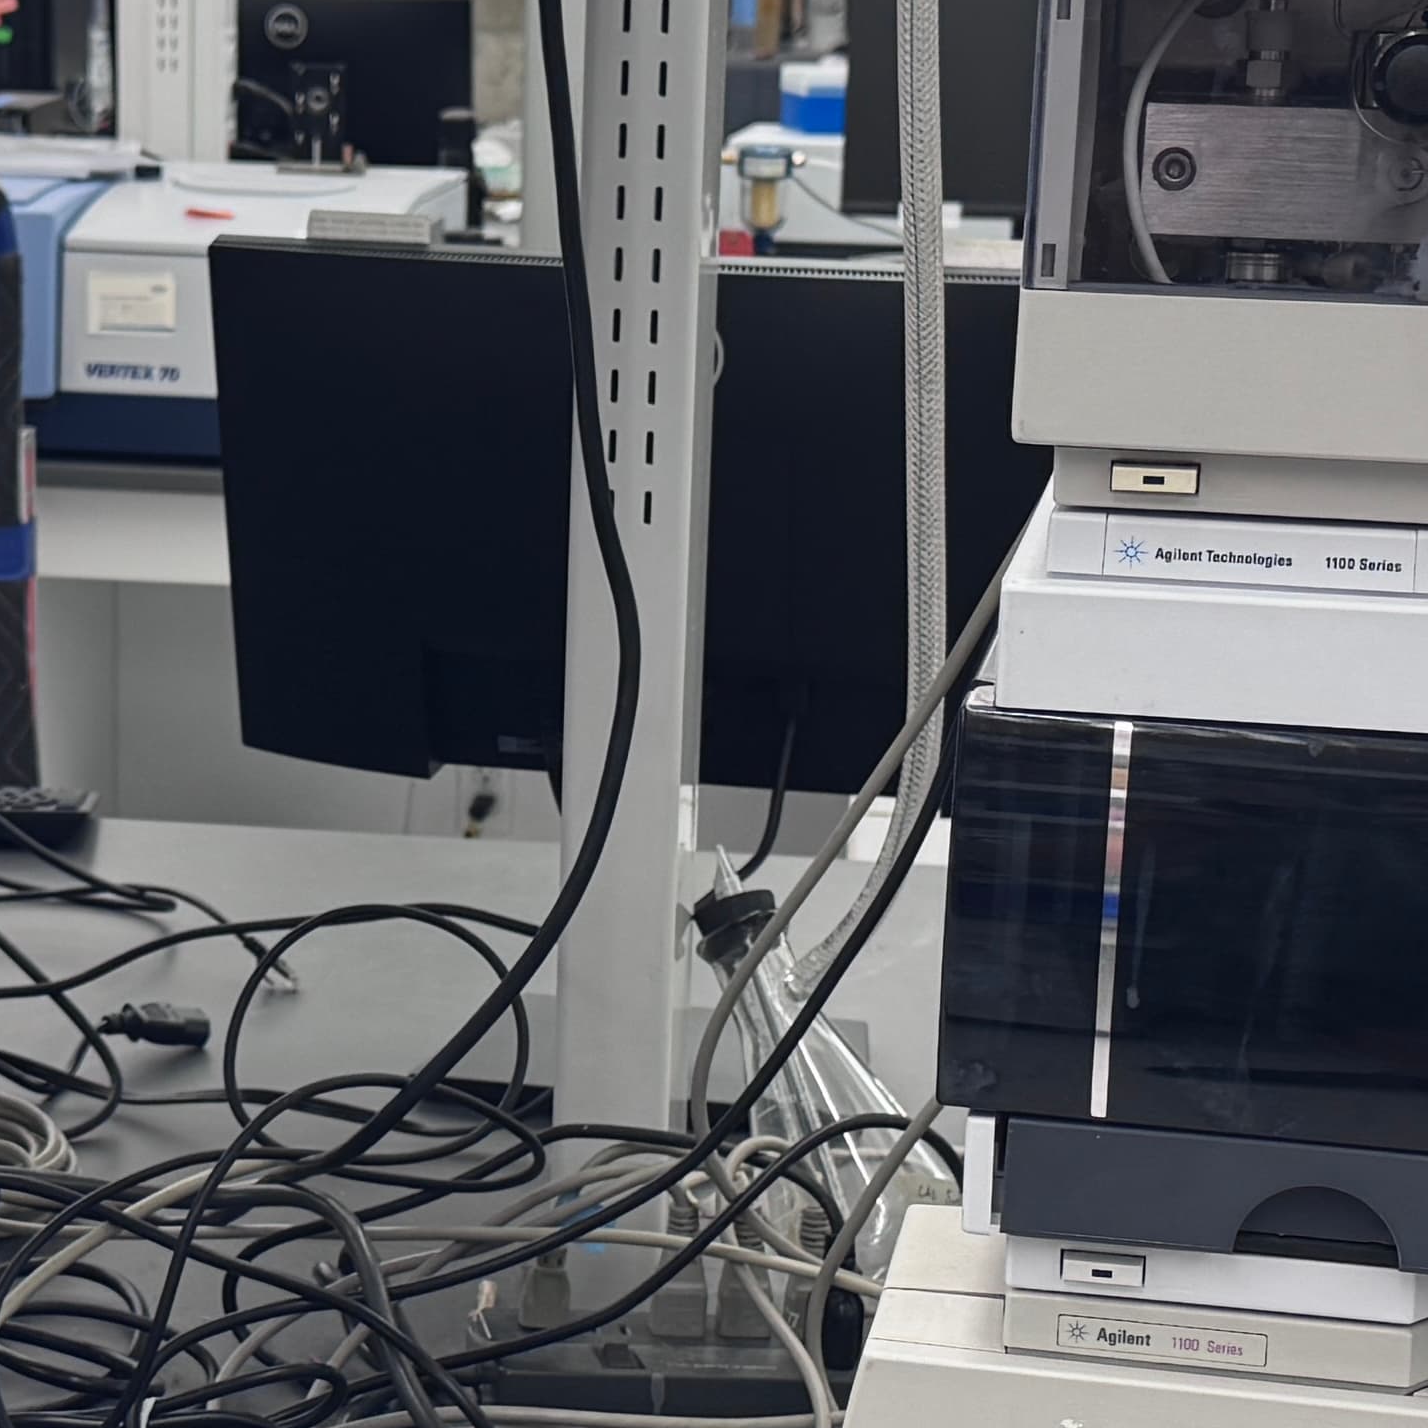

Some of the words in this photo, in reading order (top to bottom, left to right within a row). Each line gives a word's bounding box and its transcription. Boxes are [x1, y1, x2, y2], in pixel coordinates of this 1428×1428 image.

[1155, 546, 1203, 563] Agilent
[1206, 549, 1293, 568] Technologies
[1325, 555, 1356, 571] 1100
[1359, 558, 1402, 573] Series
[1097, 1327, 1151, 1347] Agilent
[1172, 1336, 1199, 1352] 1100
[1207, 1340, 1243, 1356] Series
